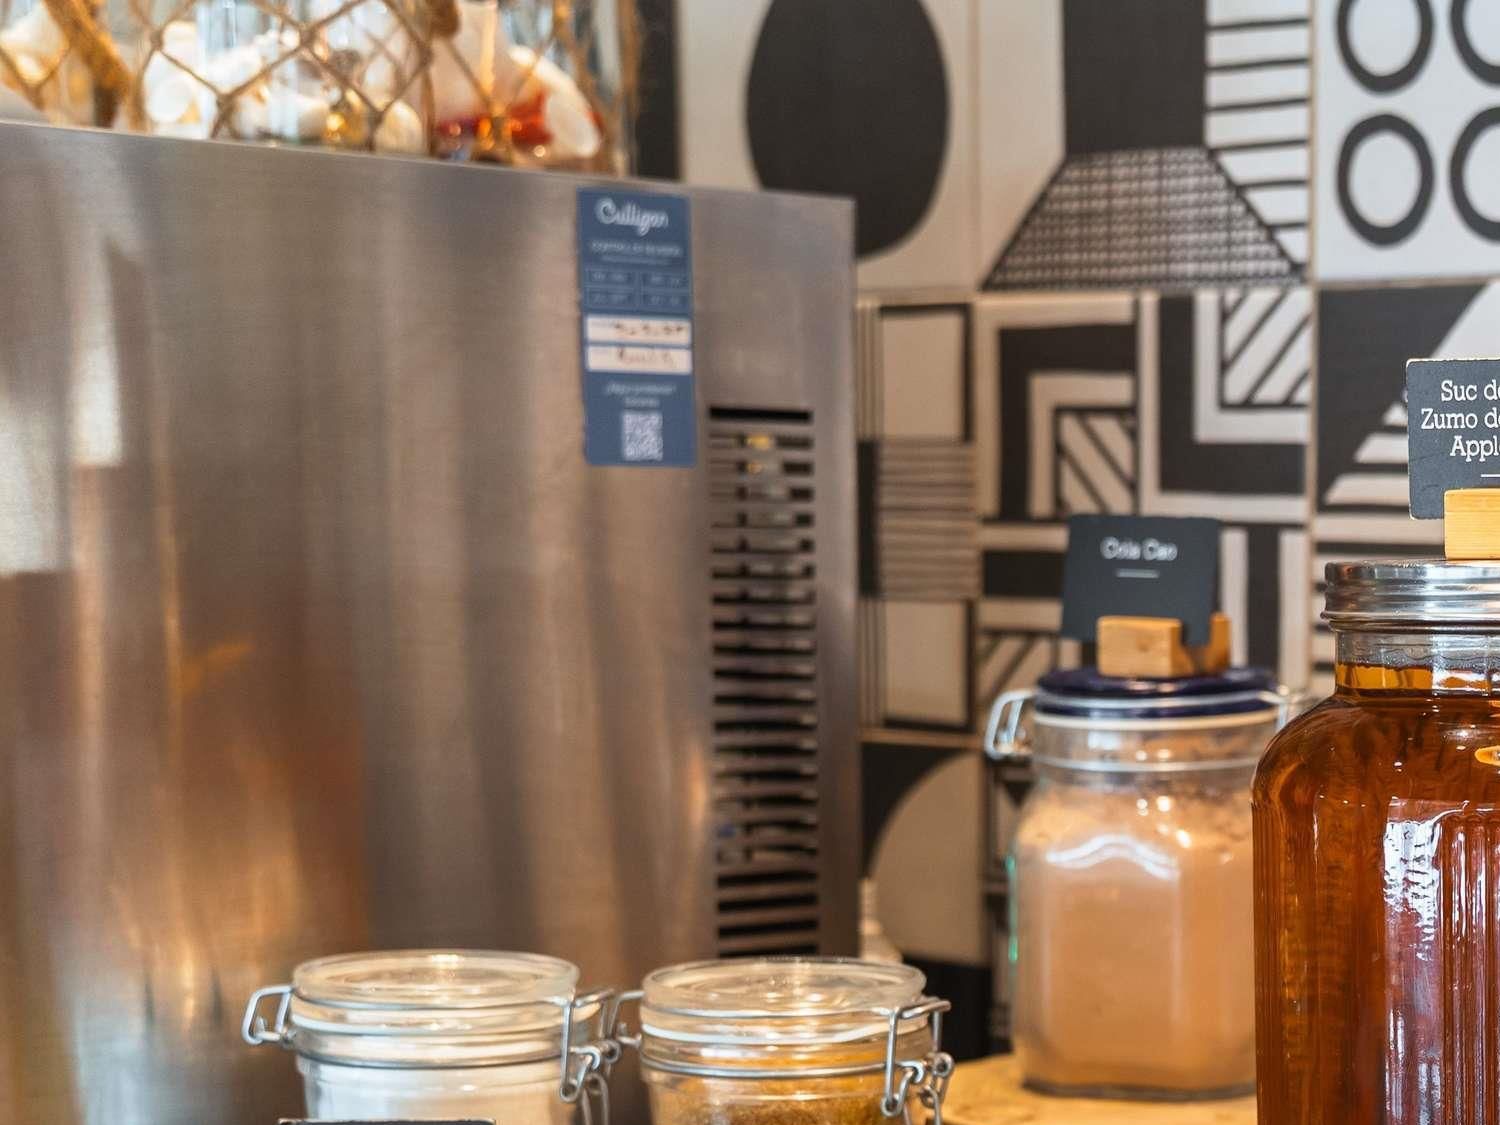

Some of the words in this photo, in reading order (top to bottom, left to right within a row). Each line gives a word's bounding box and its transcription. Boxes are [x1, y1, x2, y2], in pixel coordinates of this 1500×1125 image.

[594, 197, 669, 236] Culligan
[1440, 380, 1478, 402] Suc
[1420, 407, 1479, 430] Zumo
